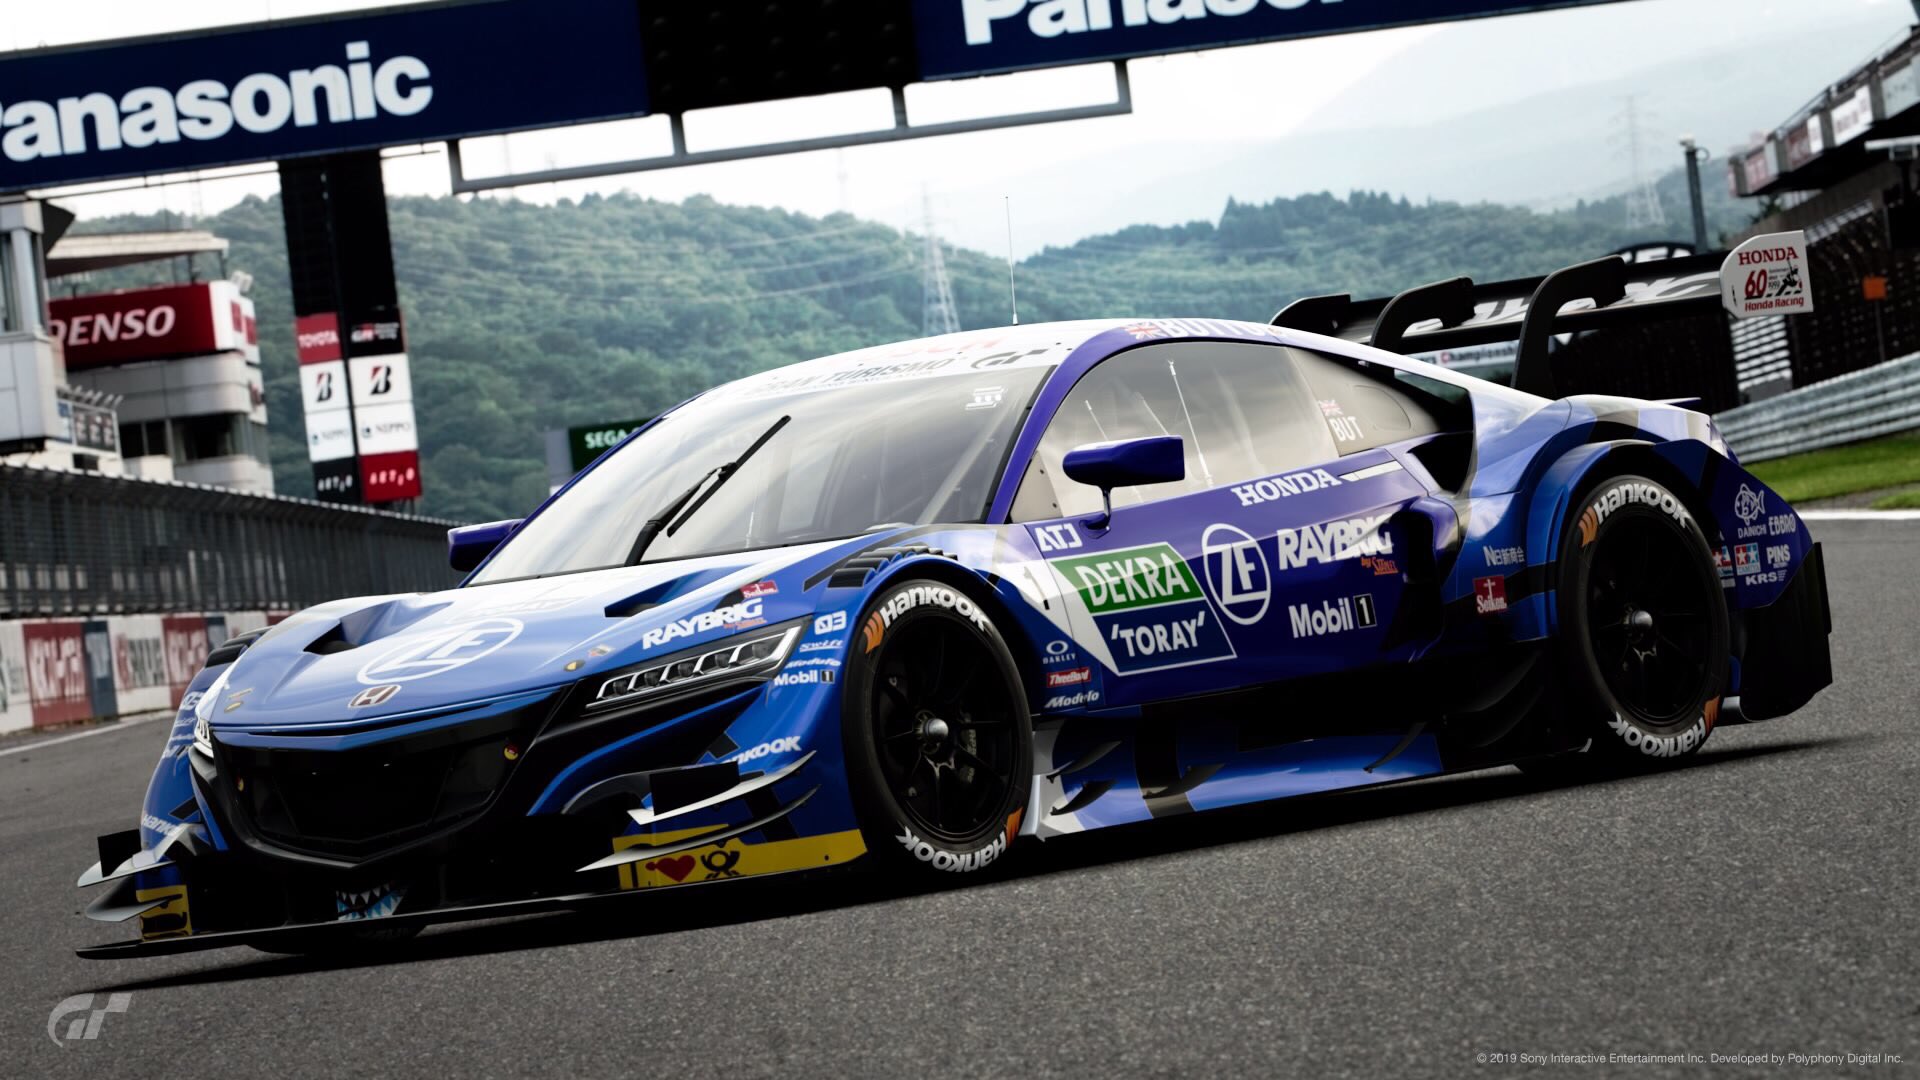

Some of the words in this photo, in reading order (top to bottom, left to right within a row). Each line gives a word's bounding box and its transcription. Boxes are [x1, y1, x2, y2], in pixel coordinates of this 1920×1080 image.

[0, 40, 433, 162] anasonic
[1738, 246, 1799, 266] HONDA
[1744, 268, 1768, 299] 60
[1744, 302, 1773, 312] Honda
[1775, 297, 1804, 307] Racing
[1329, 416, 1364, 441] BUT
[1231, 468, 1342, 507] HONDA
[1276, 512, 1394, 571] RAYBRIG
[1766, 543, 1791, 565] PINS
[1075, 552, 1190, 607] DEKRA
[1745, 571, 1778, 586] KRS
[642, 597, 763, 650] RAYBRIG
[1288, 597, 1354, 638] Mobil
[1042, 653, 1076, 665] OAKLEY
[774, 670, 818, 686] Mobil
[1044, 690, 1100, 708] Modlo
